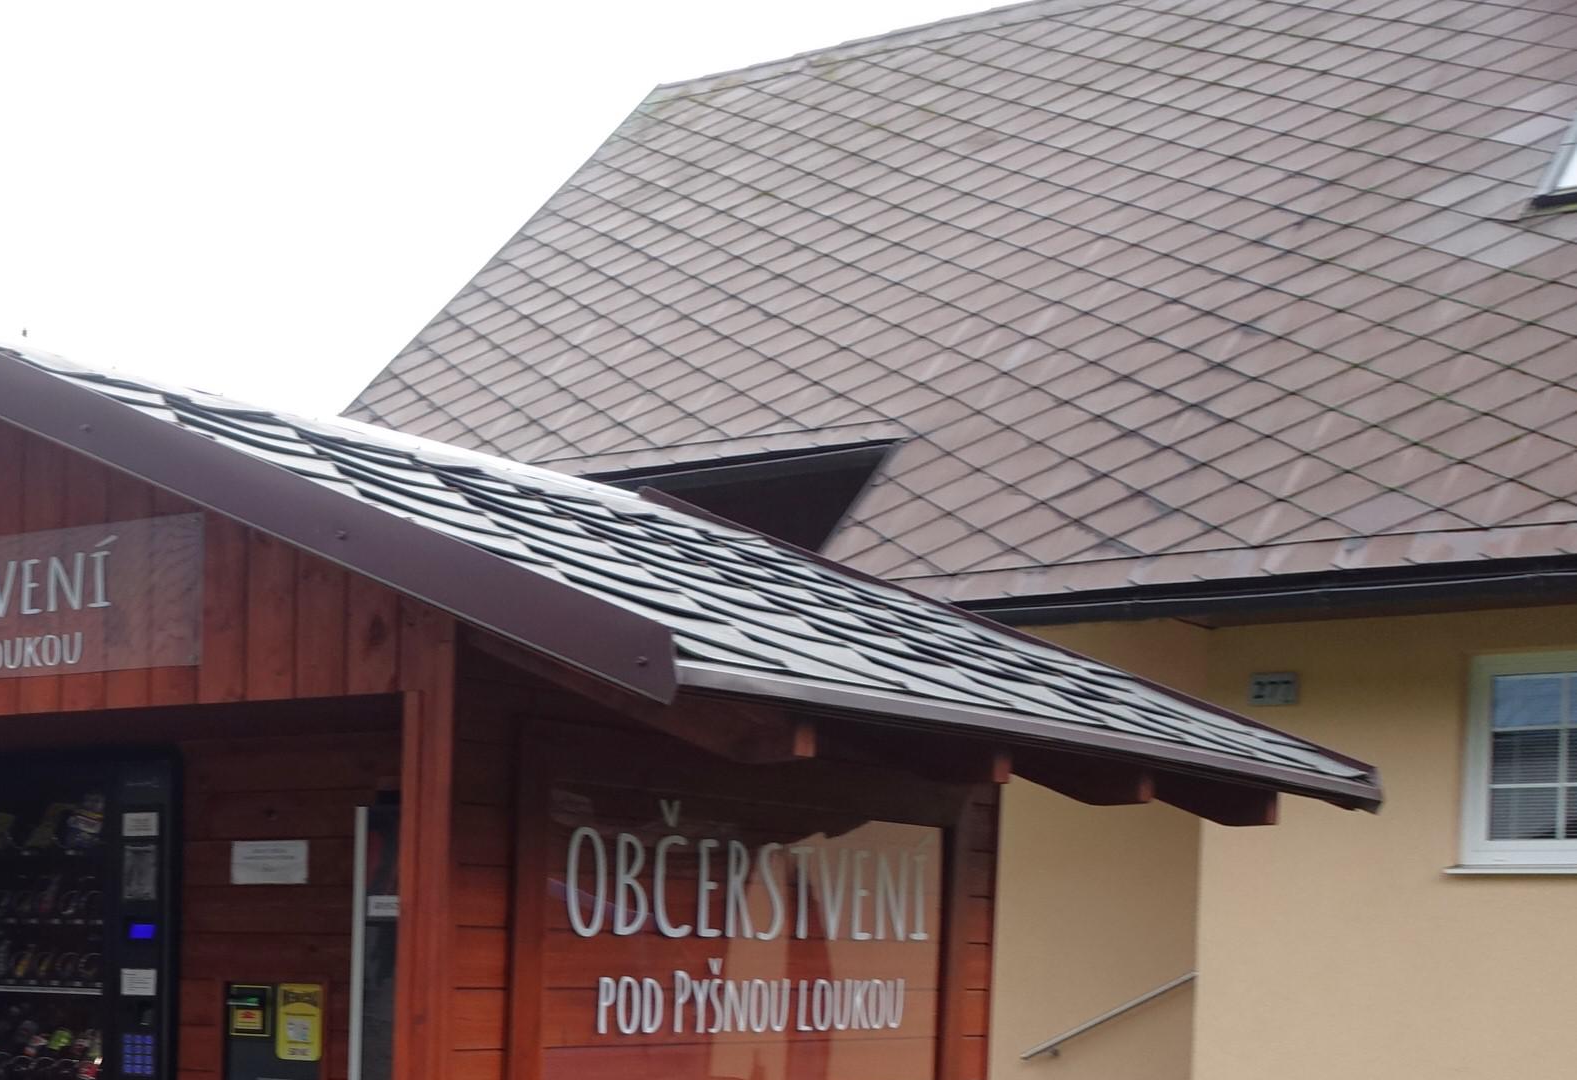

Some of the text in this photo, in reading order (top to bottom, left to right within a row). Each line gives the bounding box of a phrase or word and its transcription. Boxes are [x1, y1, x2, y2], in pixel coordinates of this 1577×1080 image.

[566, 800, 931, 941] OBČERSTVENÍ
[597, 958, 905, 1034] POD PYŠNOU LOUKOU
